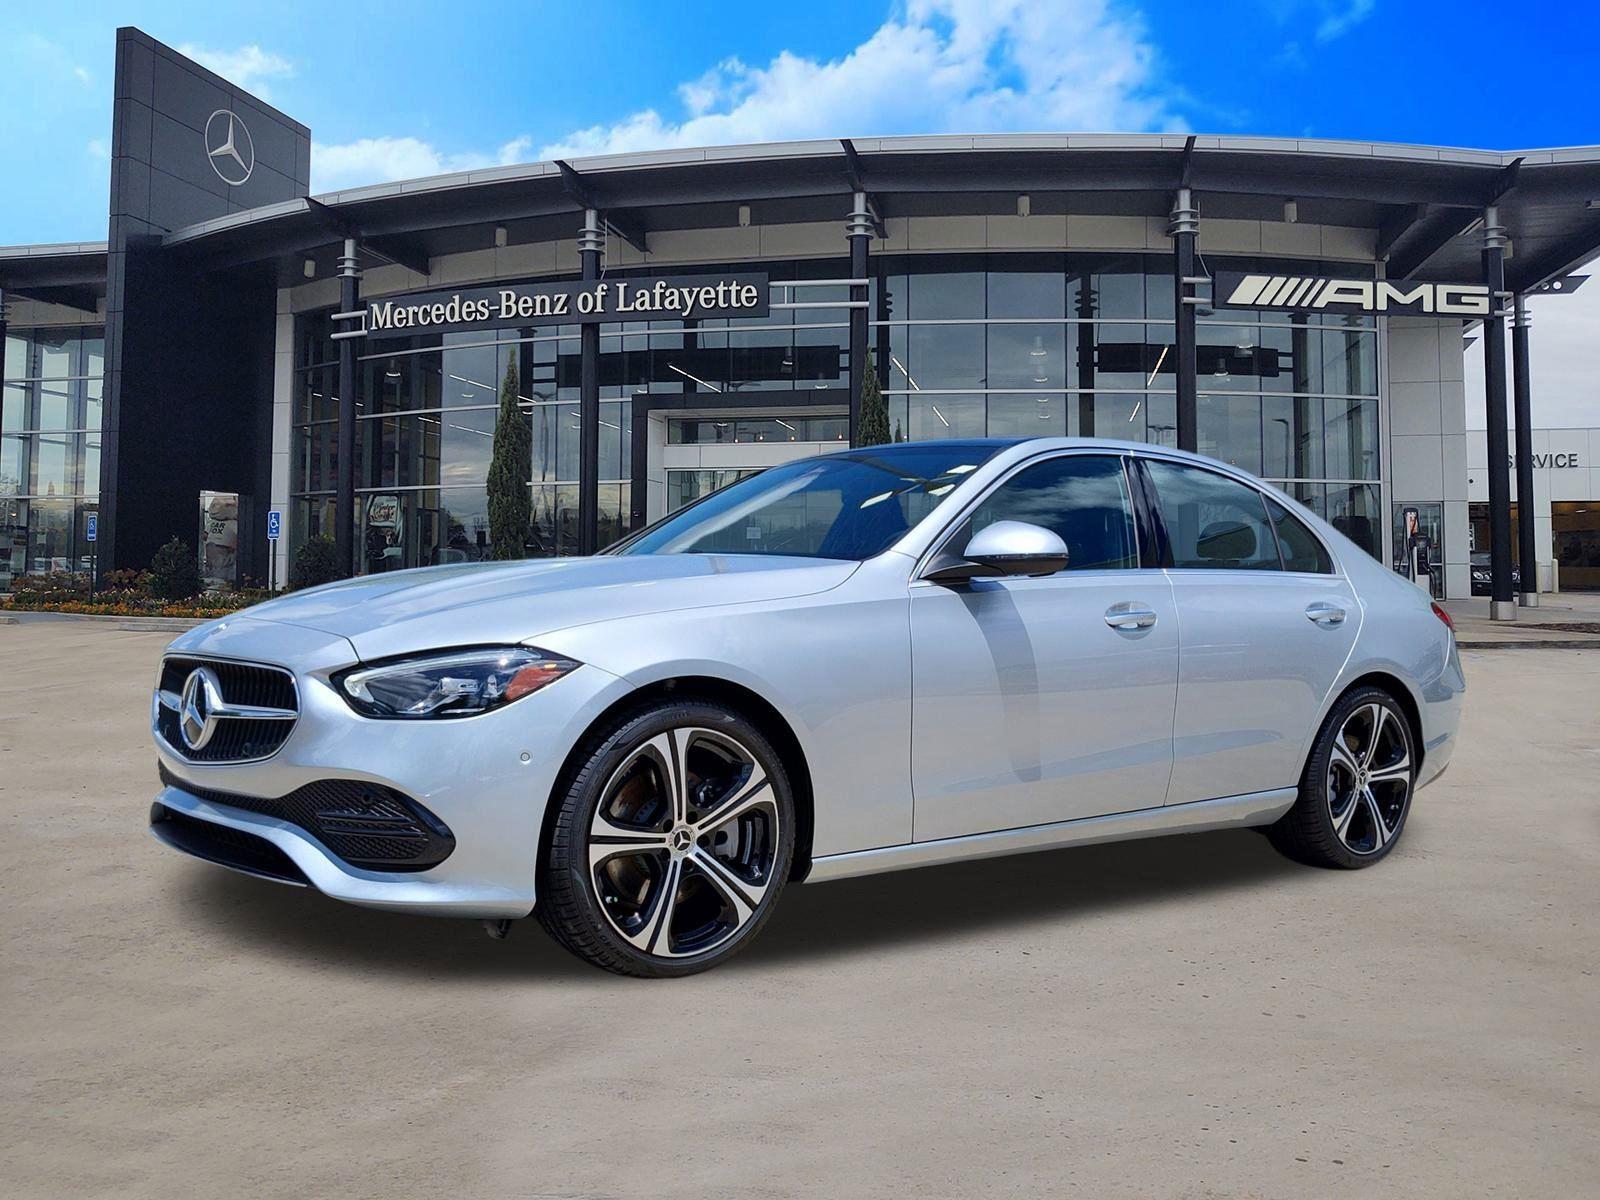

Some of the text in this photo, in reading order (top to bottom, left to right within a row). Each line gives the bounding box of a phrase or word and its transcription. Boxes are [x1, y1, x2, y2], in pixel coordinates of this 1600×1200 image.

[369, 279, 759, 330] Mercedes-Benz of Lafayette
[1312, 279, 1490, 315] AMG
[1507, 453, 1578, 468] SRVICE
